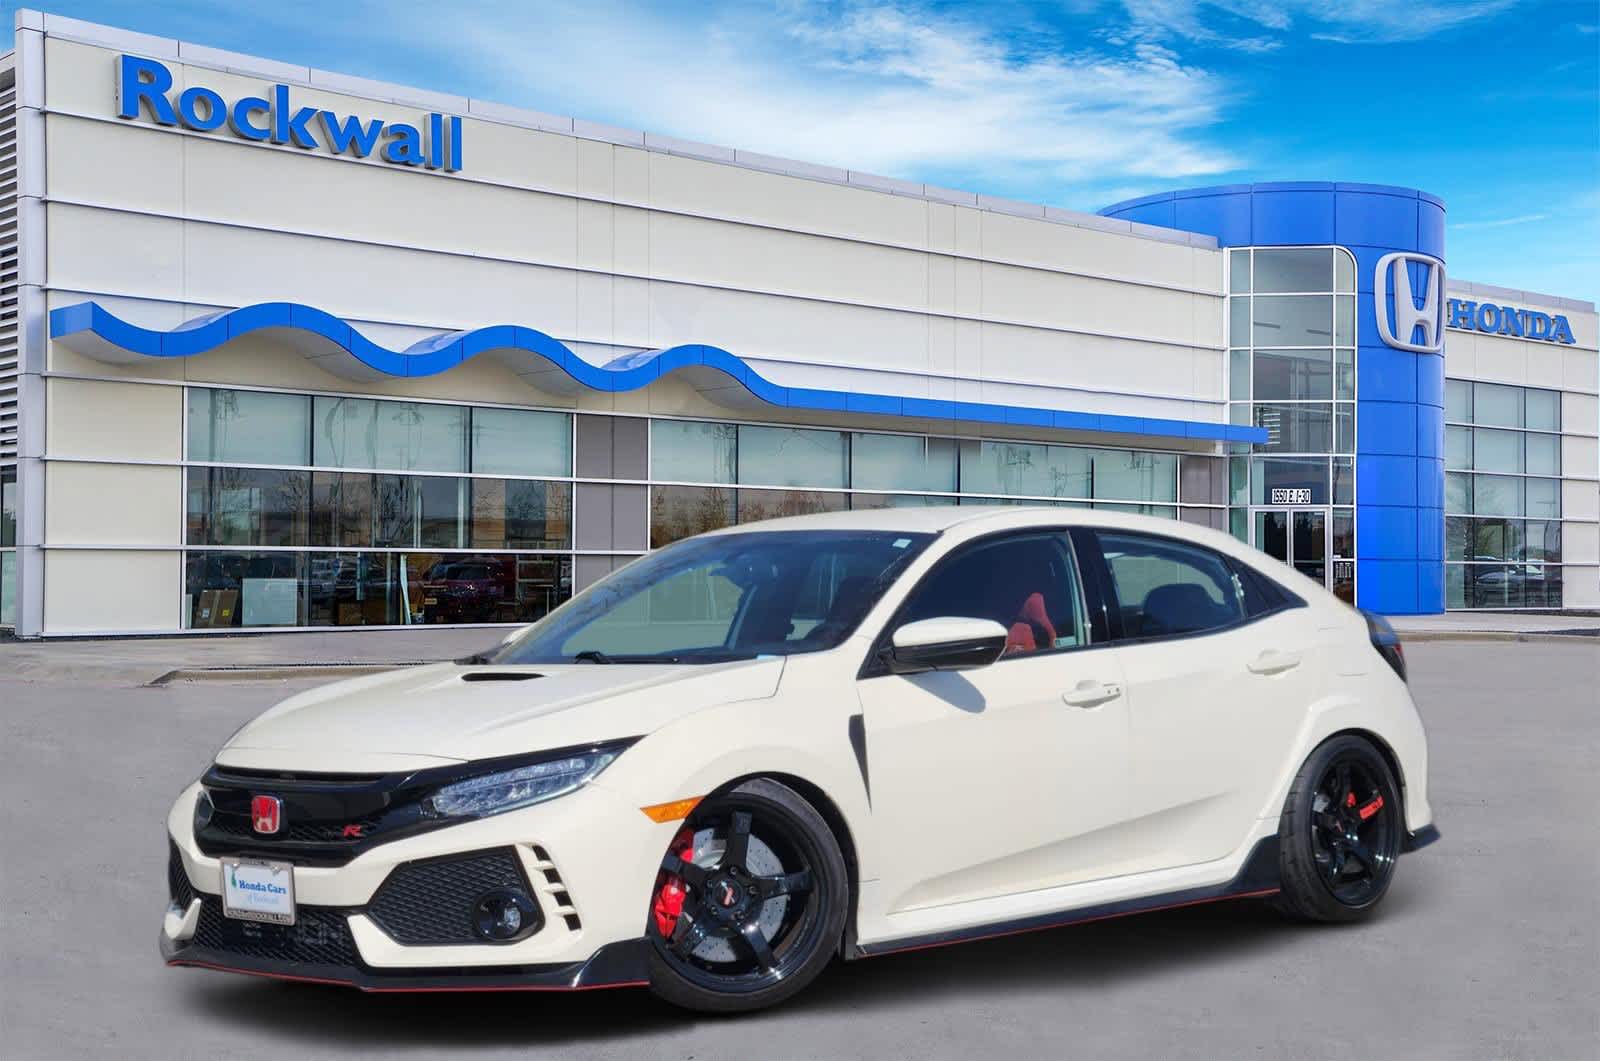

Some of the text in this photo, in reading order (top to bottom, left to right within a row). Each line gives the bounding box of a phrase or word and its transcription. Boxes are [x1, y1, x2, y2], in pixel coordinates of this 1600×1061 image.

[116, 54, 463, 173] Rockwall
[1447, 298, 1577, 345] HONDA
[238, 879, 287, 895] Honda Cars
